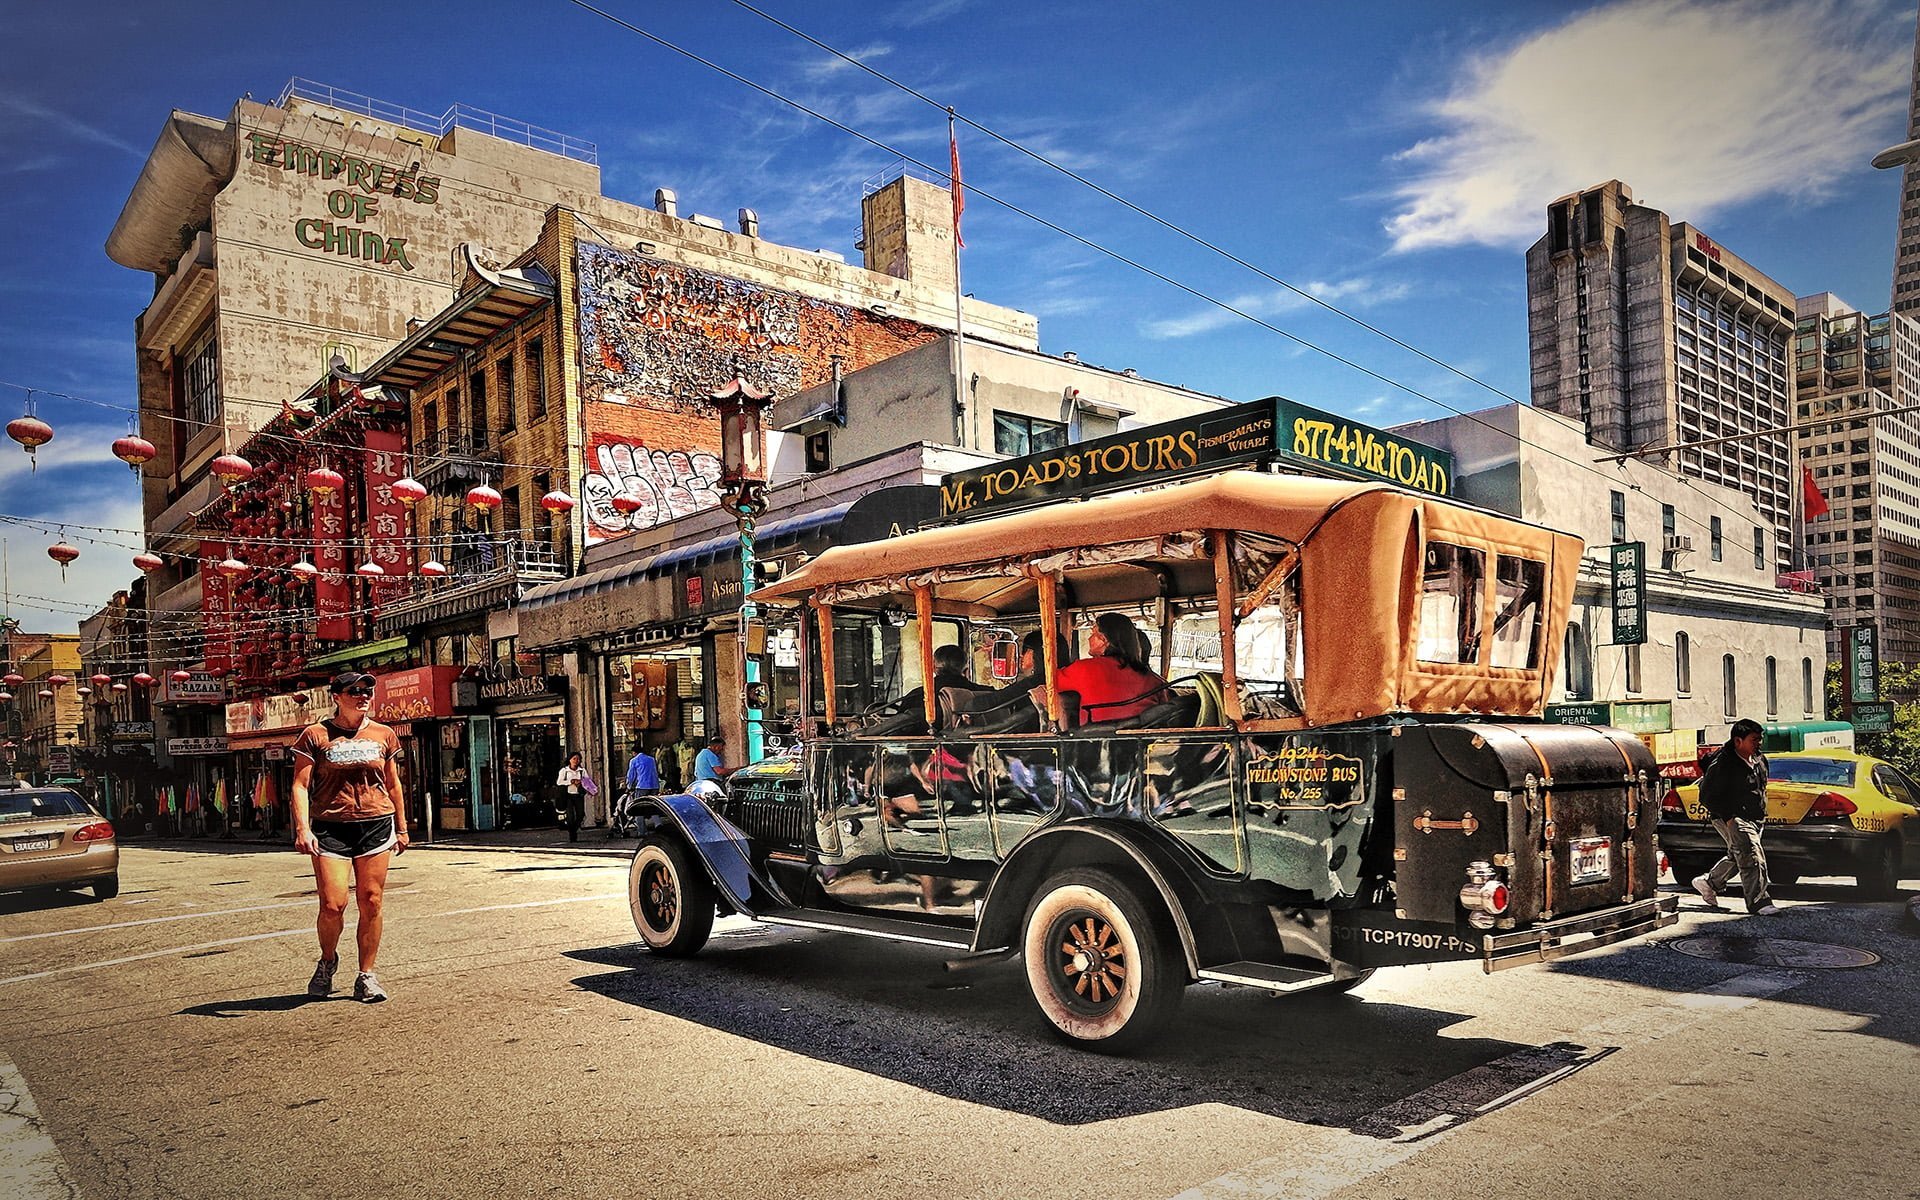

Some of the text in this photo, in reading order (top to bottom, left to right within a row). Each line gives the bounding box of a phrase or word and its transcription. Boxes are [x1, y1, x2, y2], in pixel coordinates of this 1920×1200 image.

[245, 132, 442, 205] EMPRESS
[328, 190, 379, 223] OF
[295, 219, 415, 272] CHINA
[1083, 430, 1198, 475] TOURS
[711, 579, 741, 599] Asian
[1554, 707, 1599, 716] ORIENTAL
[1561, 716, 1591, 725] PEARL
[1279, 746, 1319, 765] 1924
[1248, 767, 1357, 783] YELLOWSTONE BUS
[1302, 787, 1321, 799] 255
[1855, 817, 1885, 832] 333-3333
